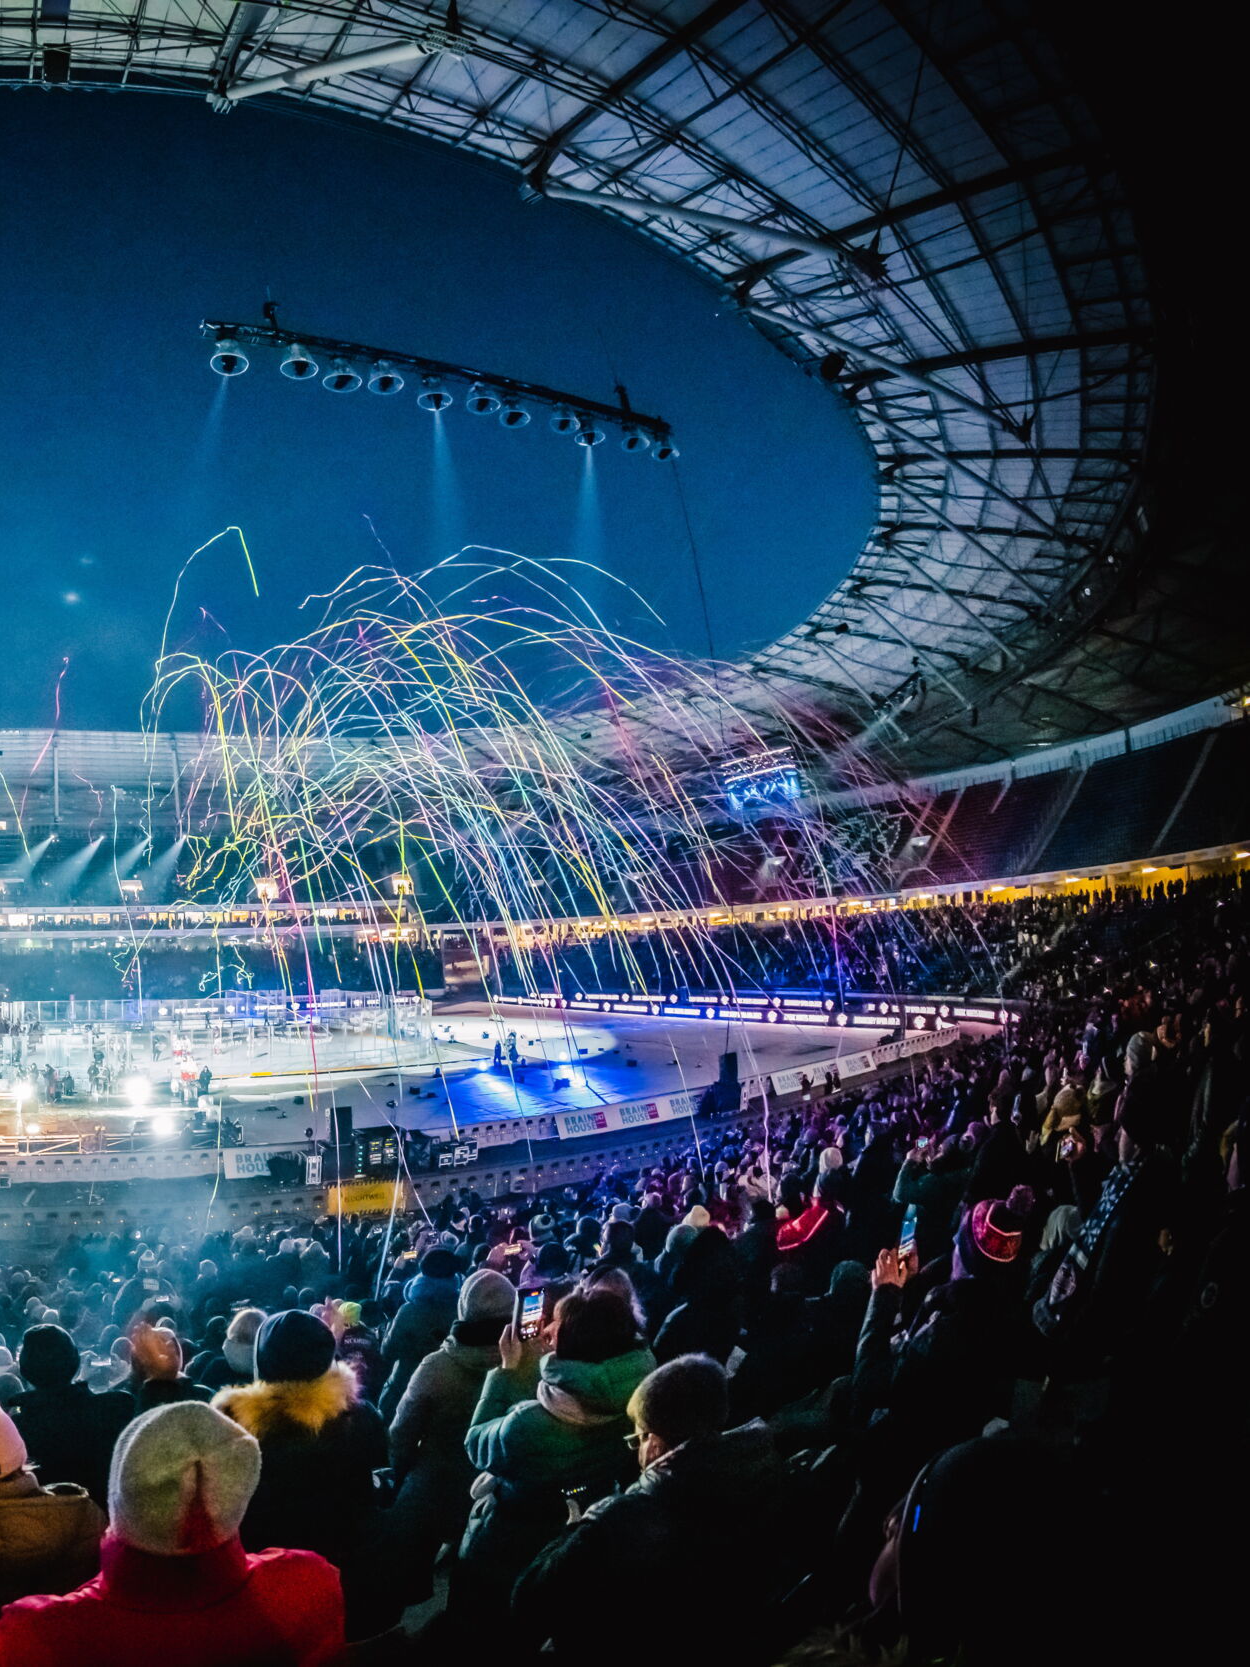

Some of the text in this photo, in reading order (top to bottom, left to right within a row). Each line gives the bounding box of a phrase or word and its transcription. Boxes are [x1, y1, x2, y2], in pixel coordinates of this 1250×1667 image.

[619, 1105, 647, 1117] BRAIN
[564, 1113, 594, 1126] BRAIN
[622, 1112, 650, 1125] HOUSE
[566, 1121, 597, 1134] HOUSE
